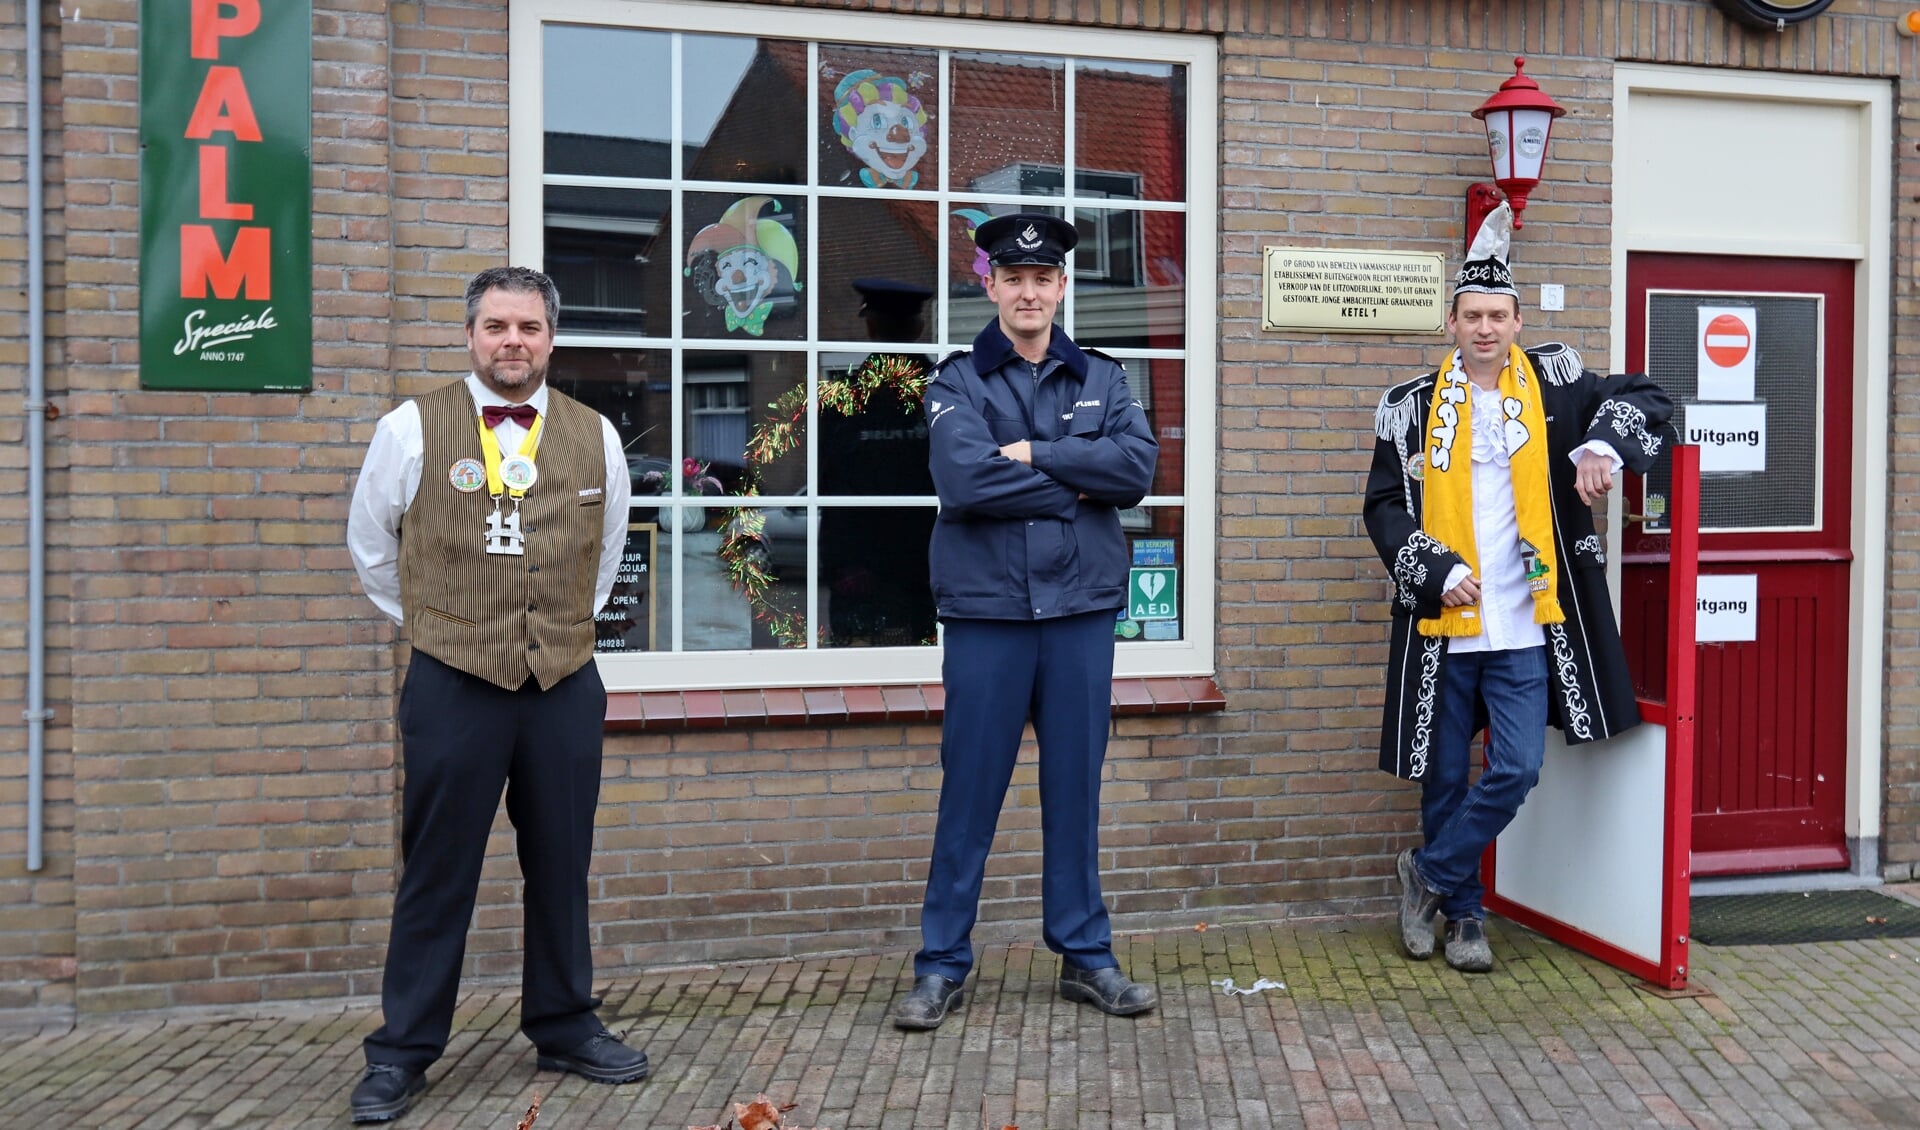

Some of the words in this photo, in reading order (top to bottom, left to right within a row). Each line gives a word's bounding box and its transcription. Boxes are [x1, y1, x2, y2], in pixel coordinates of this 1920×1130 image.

[180, 0, 271, 300] PALM
[1294, 260, 1315, 268] GROND
[1330, 262, 1357, 270] BEWEZEN
[1359, 263, 1401, 271] VAKMANSCHAP
[1403, 264, 1421, 272] HEEFT
[1274, 271, 1322, 280] ETABLISSEMENT
[1325, 273, 1371, 281] BUITENGEWOON
[1394, 275, 1428, 283] VERWORVEN
[1279, 283, 1308, 291] VERKOOP
[1323, 284, 1331, 292] DE
[1415, 287, 1436, 295] GRANEN
[1321, 296, 1340, 304] JONGE
[1342, 296, 1389, 305] AMBACHTELIJKE
[1391, 298, 1433, 307] GRAANJENEVER
[1341, 308, 1368, 317] KETEL
[1373, 309, 1376, 317] 1
[173, 307, 277, 356] Speciale
[200, 351, 225, 362] ANNO
[227, 352, 245, 362] 1747
[1690, 428, 1759, 447] Uitgang
[625, 553, 641, 562] UUR
[632, 564, 647, 573] UUR
[623, 575, 638, 583] UUR
[1697, 598, 1747, 614] itgang
